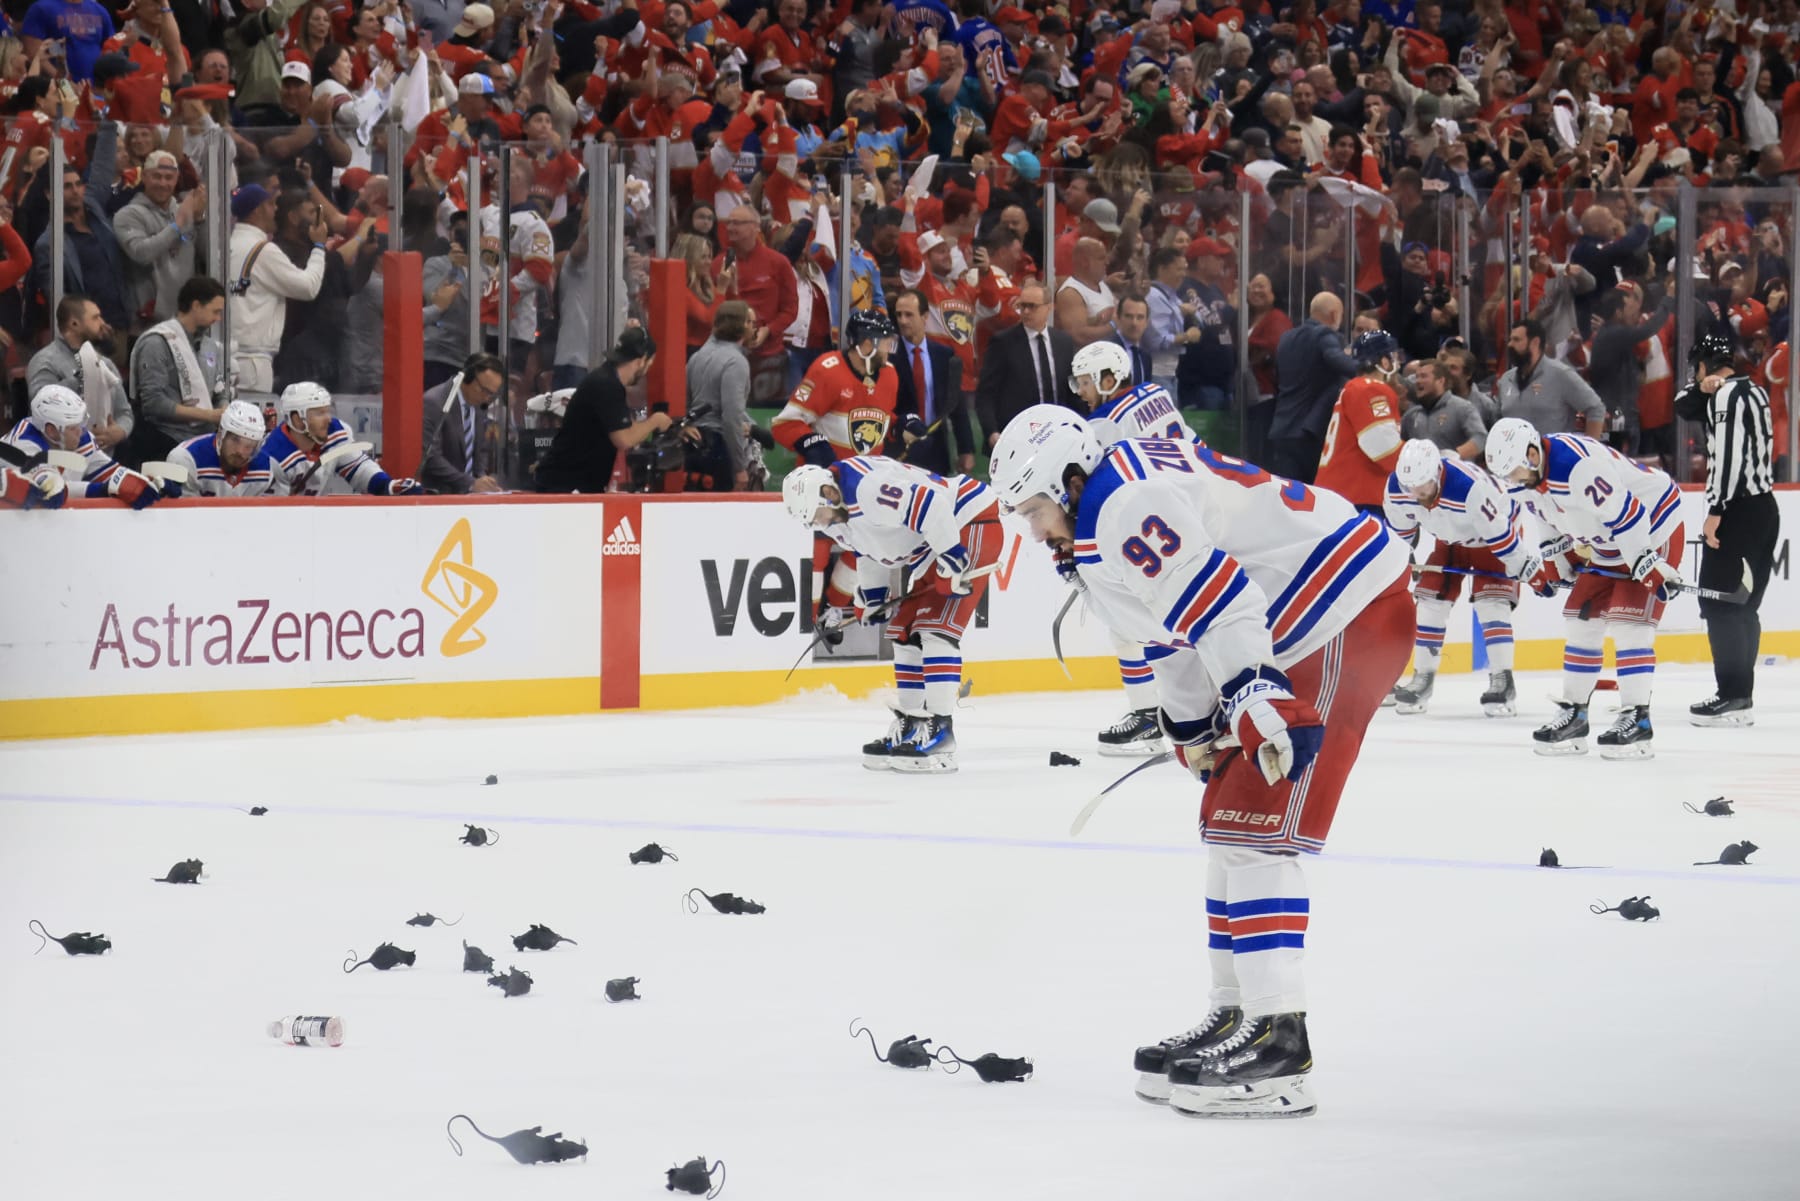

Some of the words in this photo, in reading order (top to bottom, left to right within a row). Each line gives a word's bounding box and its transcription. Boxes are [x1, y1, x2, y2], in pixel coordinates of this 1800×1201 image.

[852, 410, 884, 421] PANTHERS
[1132, 396, 1176, 432] PANARIN
[876, 483, 904, 511] 16
[1585, 475, 1614, 508] 20
[1480, 497, 1498, 522] 13
[602, 542, 641, 556] adidas
[1122, 515, 1181, 578] 93
[1609, 606, 1644, 615] BAUER
[89, 599, 425, 670] AstraZeneca
[1212, 809, 1282, 827] BAUER
